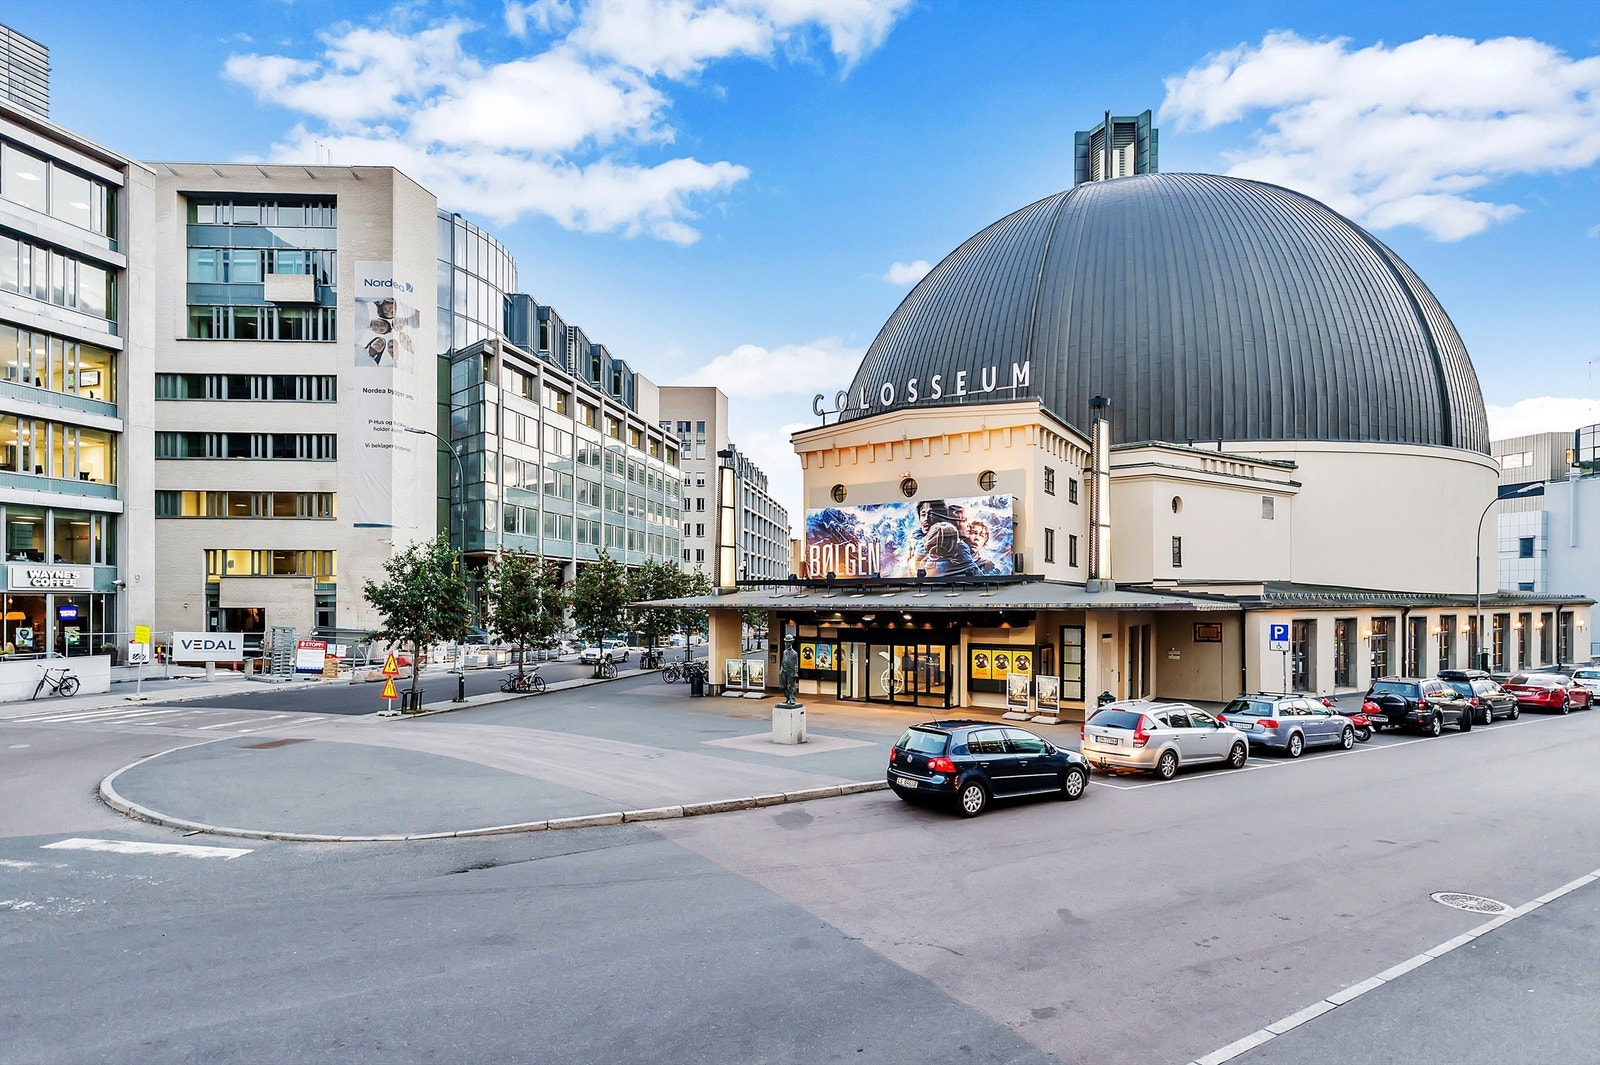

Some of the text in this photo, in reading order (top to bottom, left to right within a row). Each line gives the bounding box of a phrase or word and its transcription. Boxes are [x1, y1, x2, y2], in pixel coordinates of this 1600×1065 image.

[363, 278, 405, 293] Nordea
[812, 360, 1030, 416] COLOSSEUM
[809, 542, 880, 577] BØLGEN
[28, 570, 80, 579] WAYNE'S
[31, 578, 77, 587] COFFEE
[1274, 626, 1285, 640] P
[181, 639, 237, 650] VEDAL
